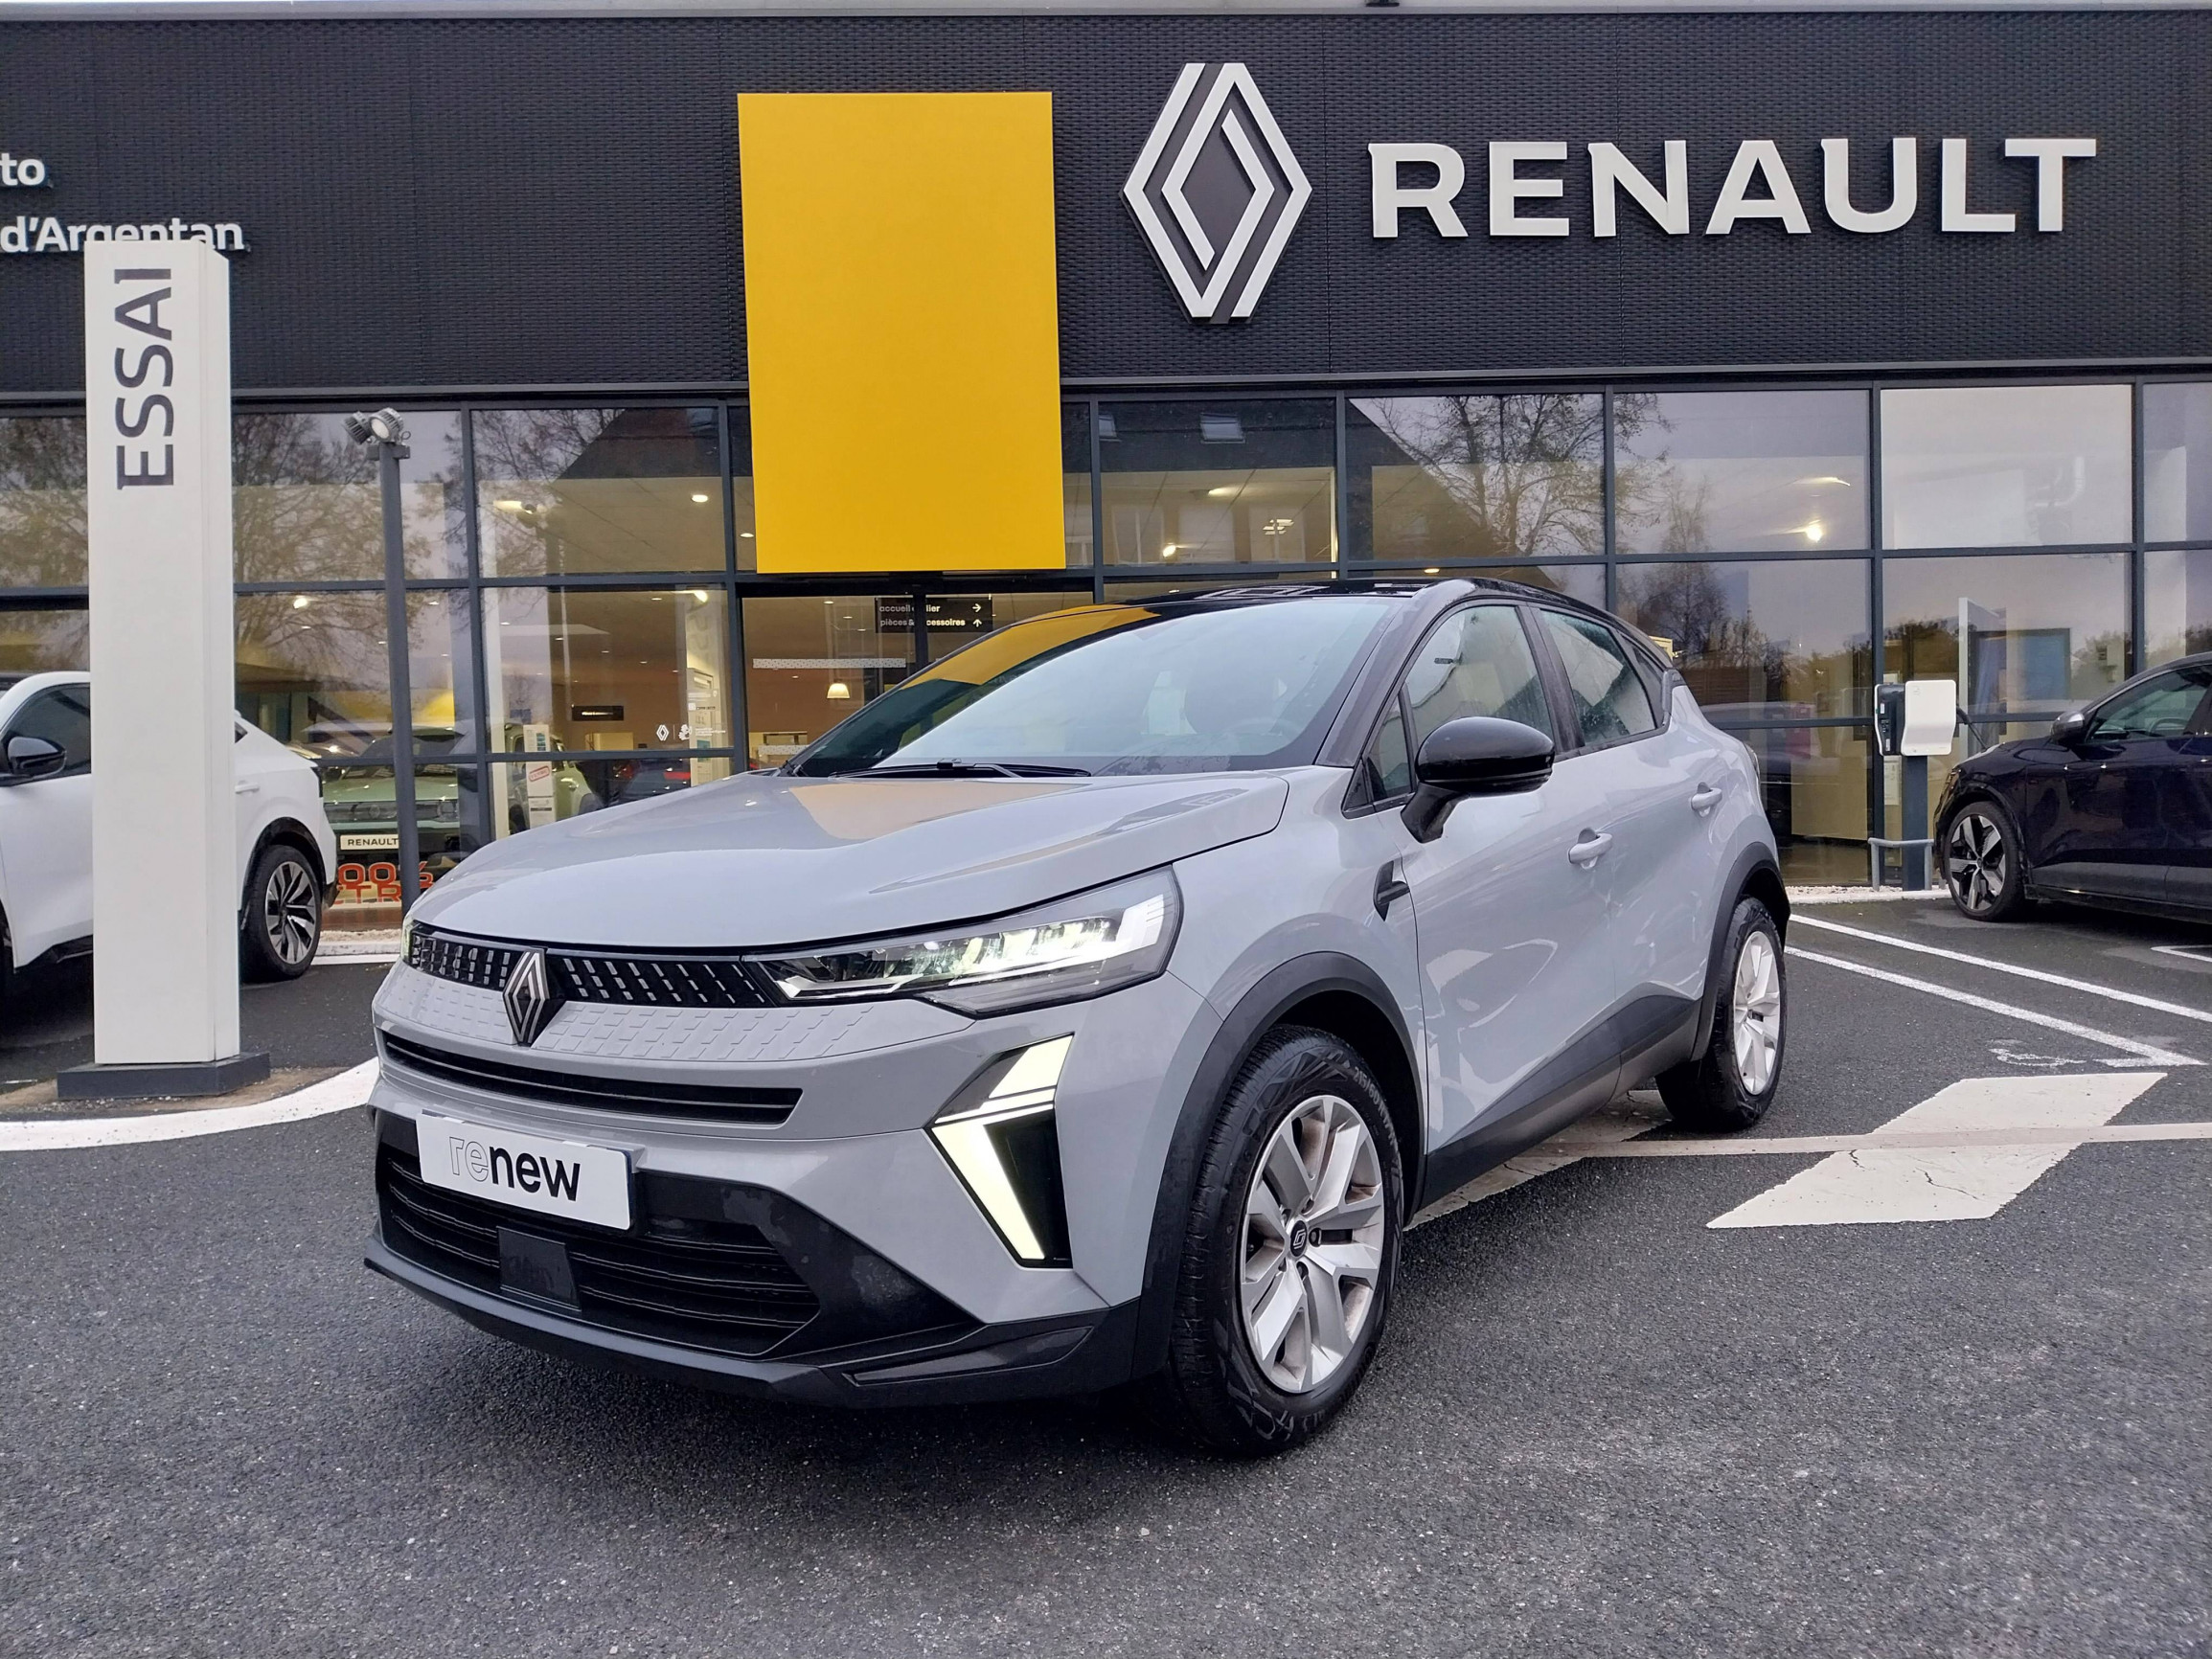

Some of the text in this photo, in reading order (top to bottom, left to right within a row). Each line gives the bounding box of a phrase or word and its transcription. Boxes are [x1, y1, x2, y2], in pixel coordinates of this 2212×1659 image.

[1367, 137, 2097, 239] RENAULT
[114, 268, 174, 490] ESSAI
[879, 603, 910, 613] accueil
[879, 618, 907, 627] pièces
[348, 837, 399, 847] RENAULT
[448, 1136, 581, 1202] renew
